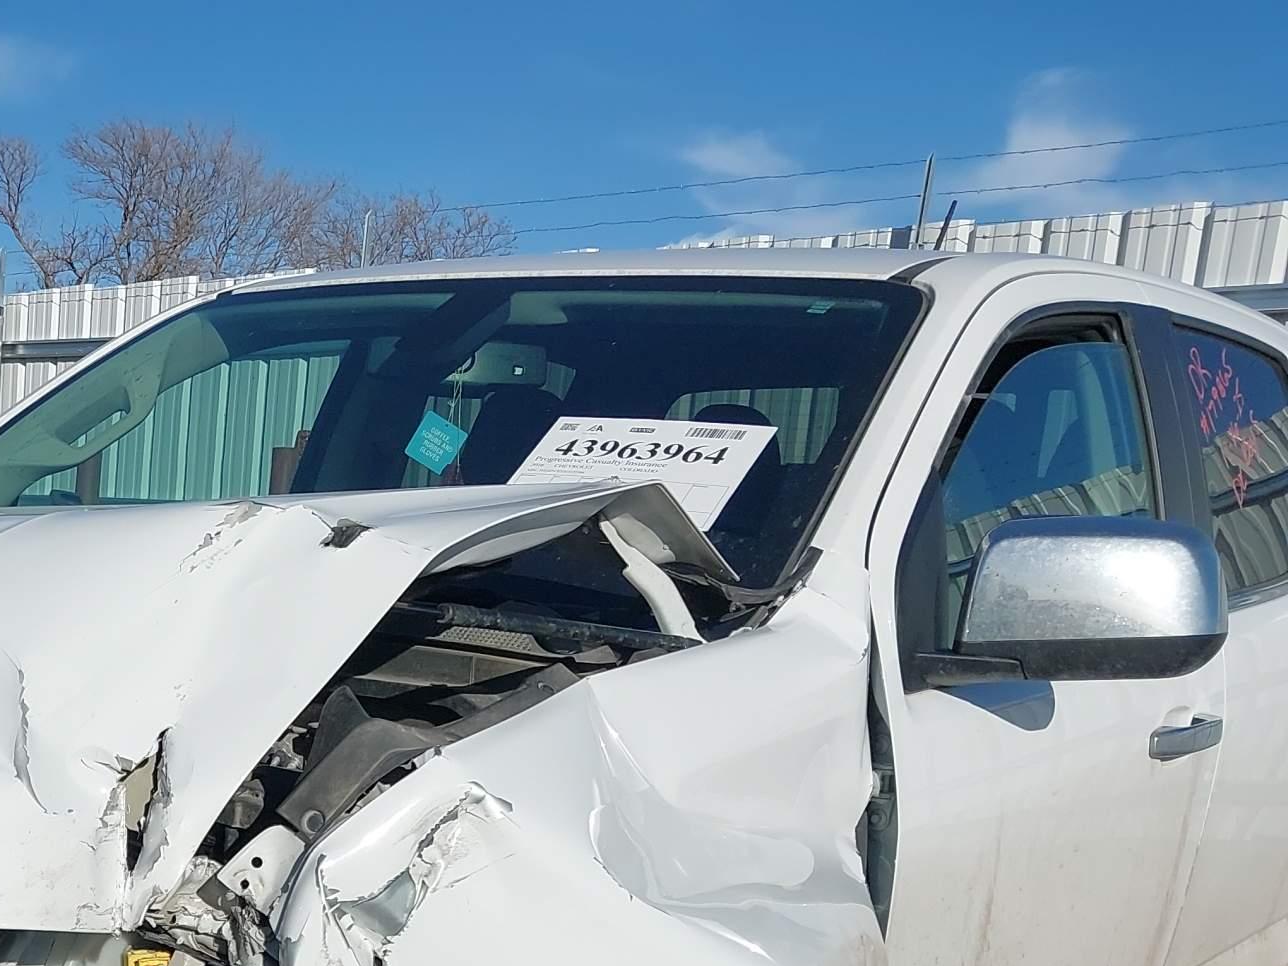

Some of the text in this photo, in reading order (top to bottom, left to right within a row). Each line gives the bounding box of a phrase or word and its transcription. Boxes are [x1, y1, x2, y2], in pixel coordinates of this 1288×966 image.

[535, 455, 669, 468] Progressive Casualty Insurance
[555, 438, 730, 465] 43963964
